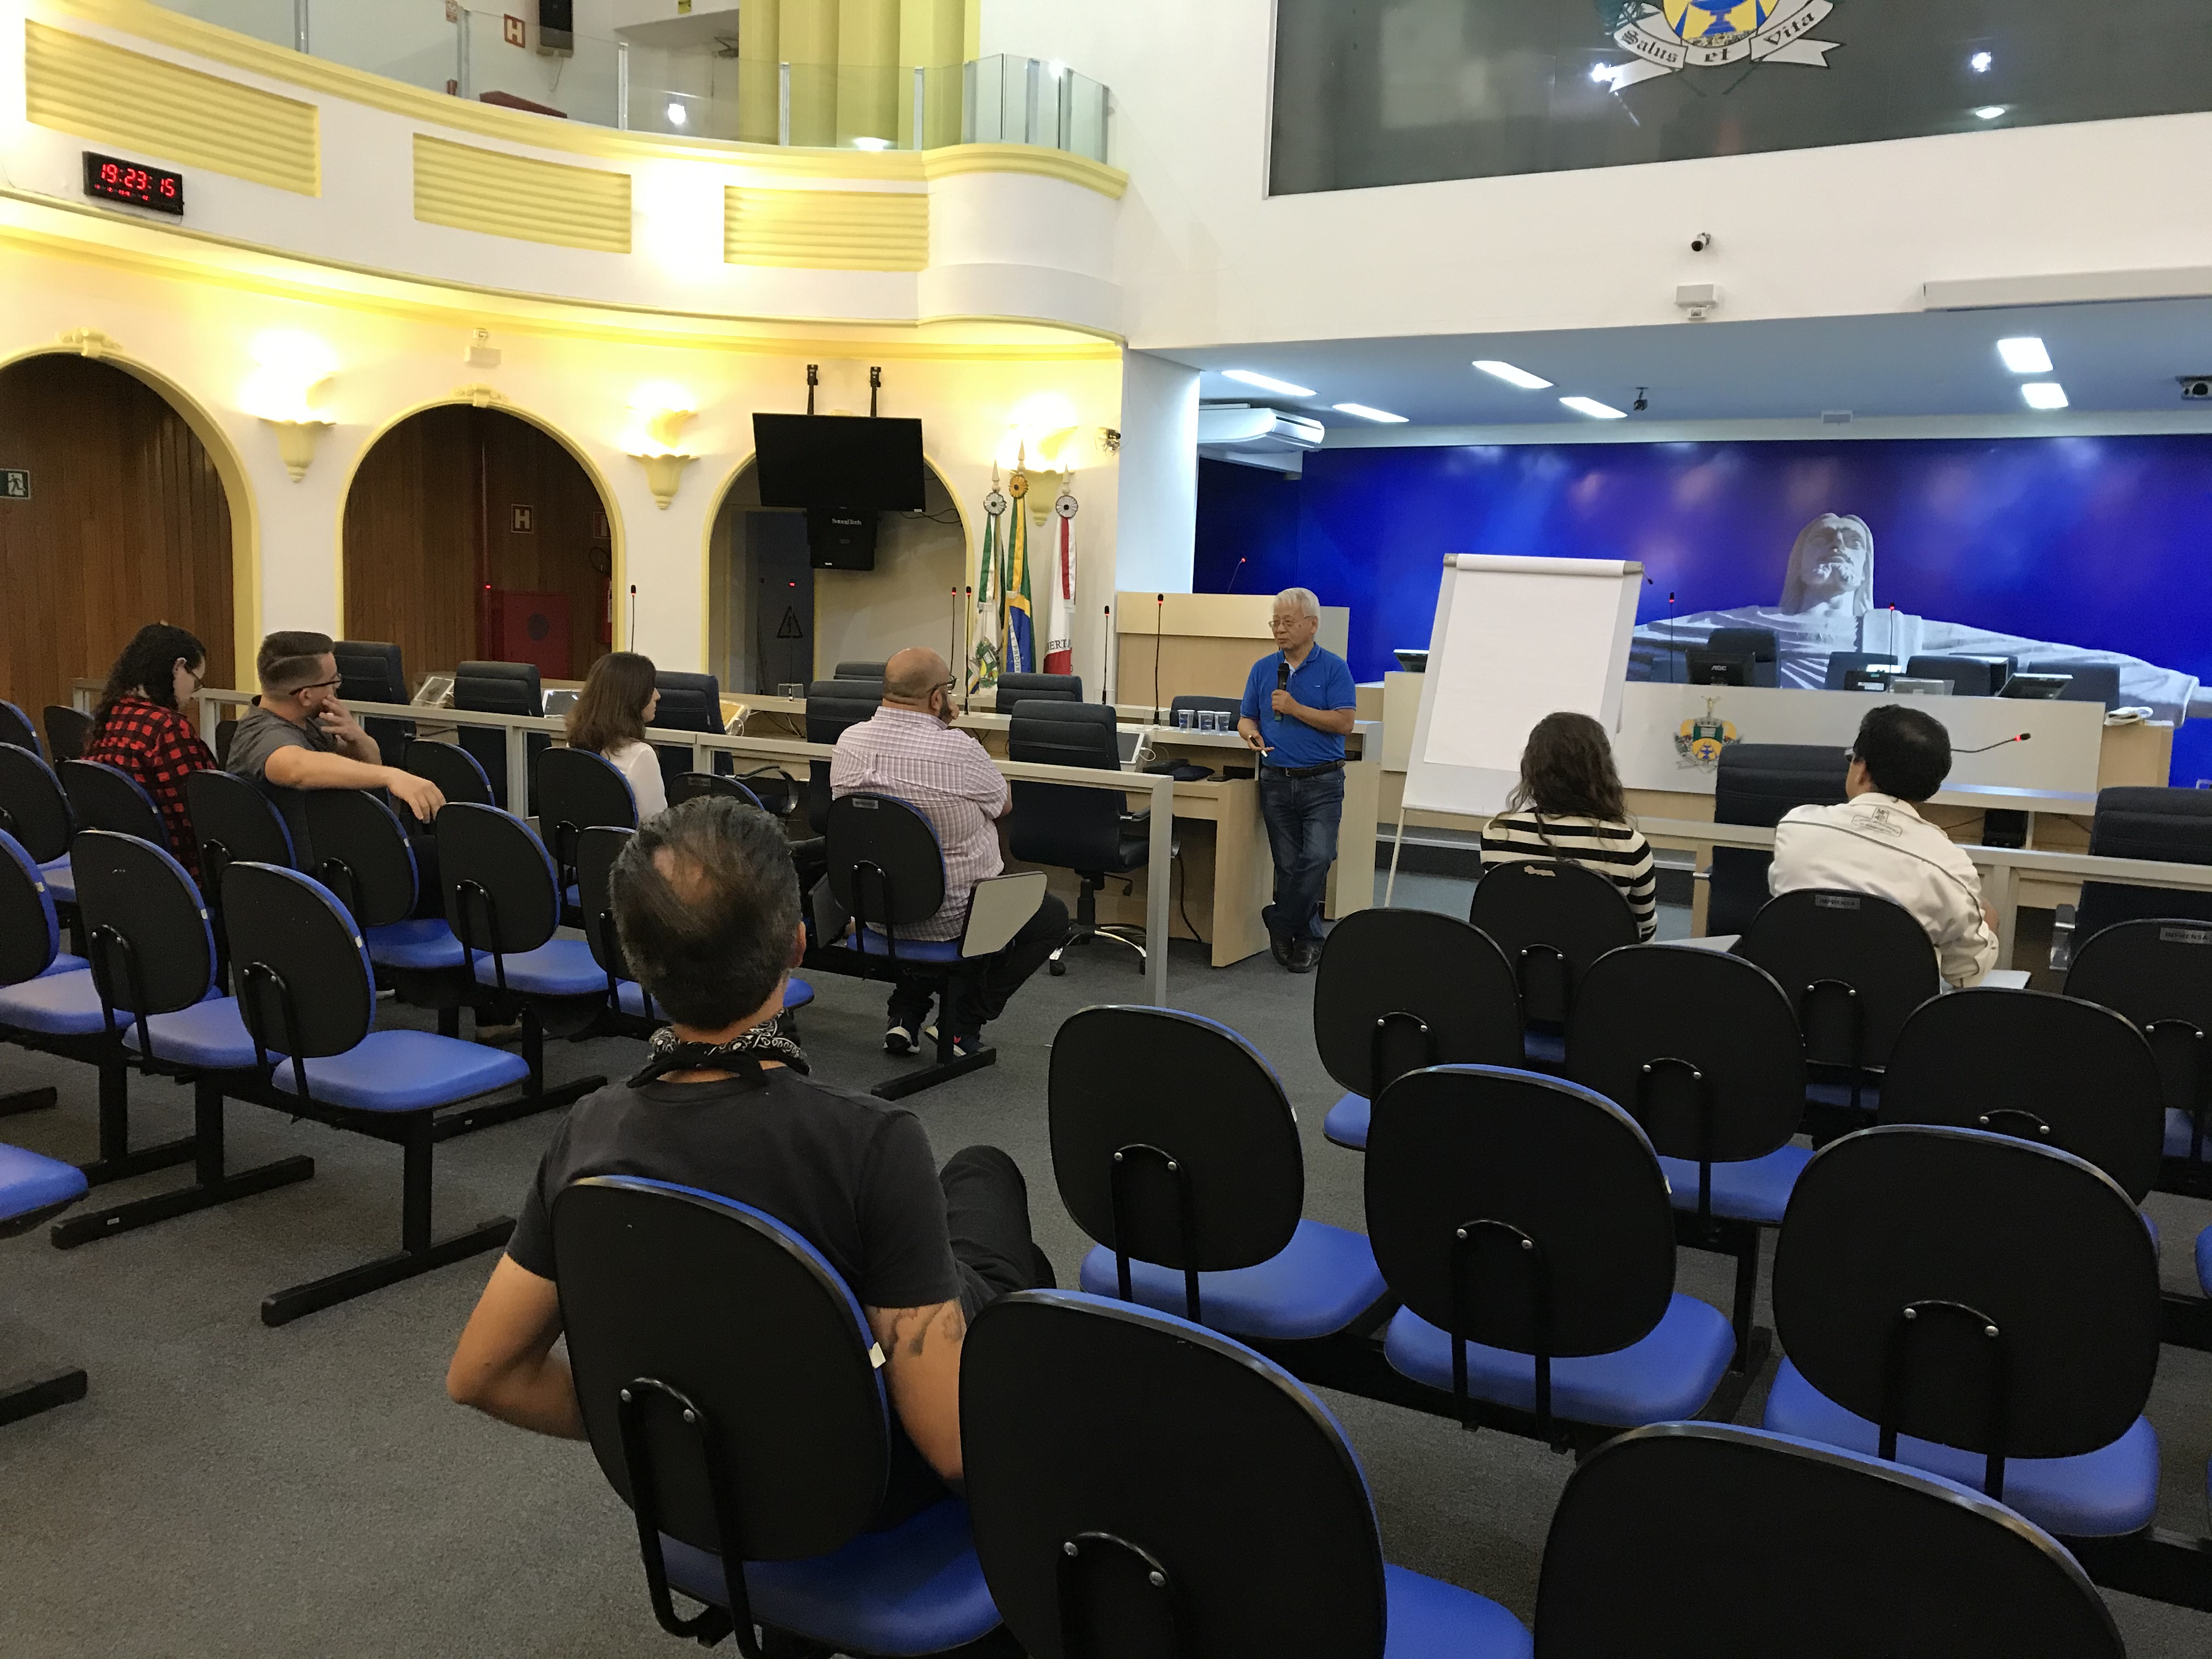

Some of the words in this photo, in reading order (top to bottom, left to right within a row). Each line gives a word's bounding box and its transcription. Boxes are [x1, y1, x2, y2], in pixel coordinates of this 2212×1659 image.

[507, 19, 522, 44] H
[1621, 30, 1678, 63] Salus
[1704, 48, 1730, 62] et
[1763, 12, 1815, 45] Vita
[515, 509, 531, 529] H
[1819, 898, 1855, 906] IMPRENSA
[2165, 932, 2209, 940] IMPRENSA
